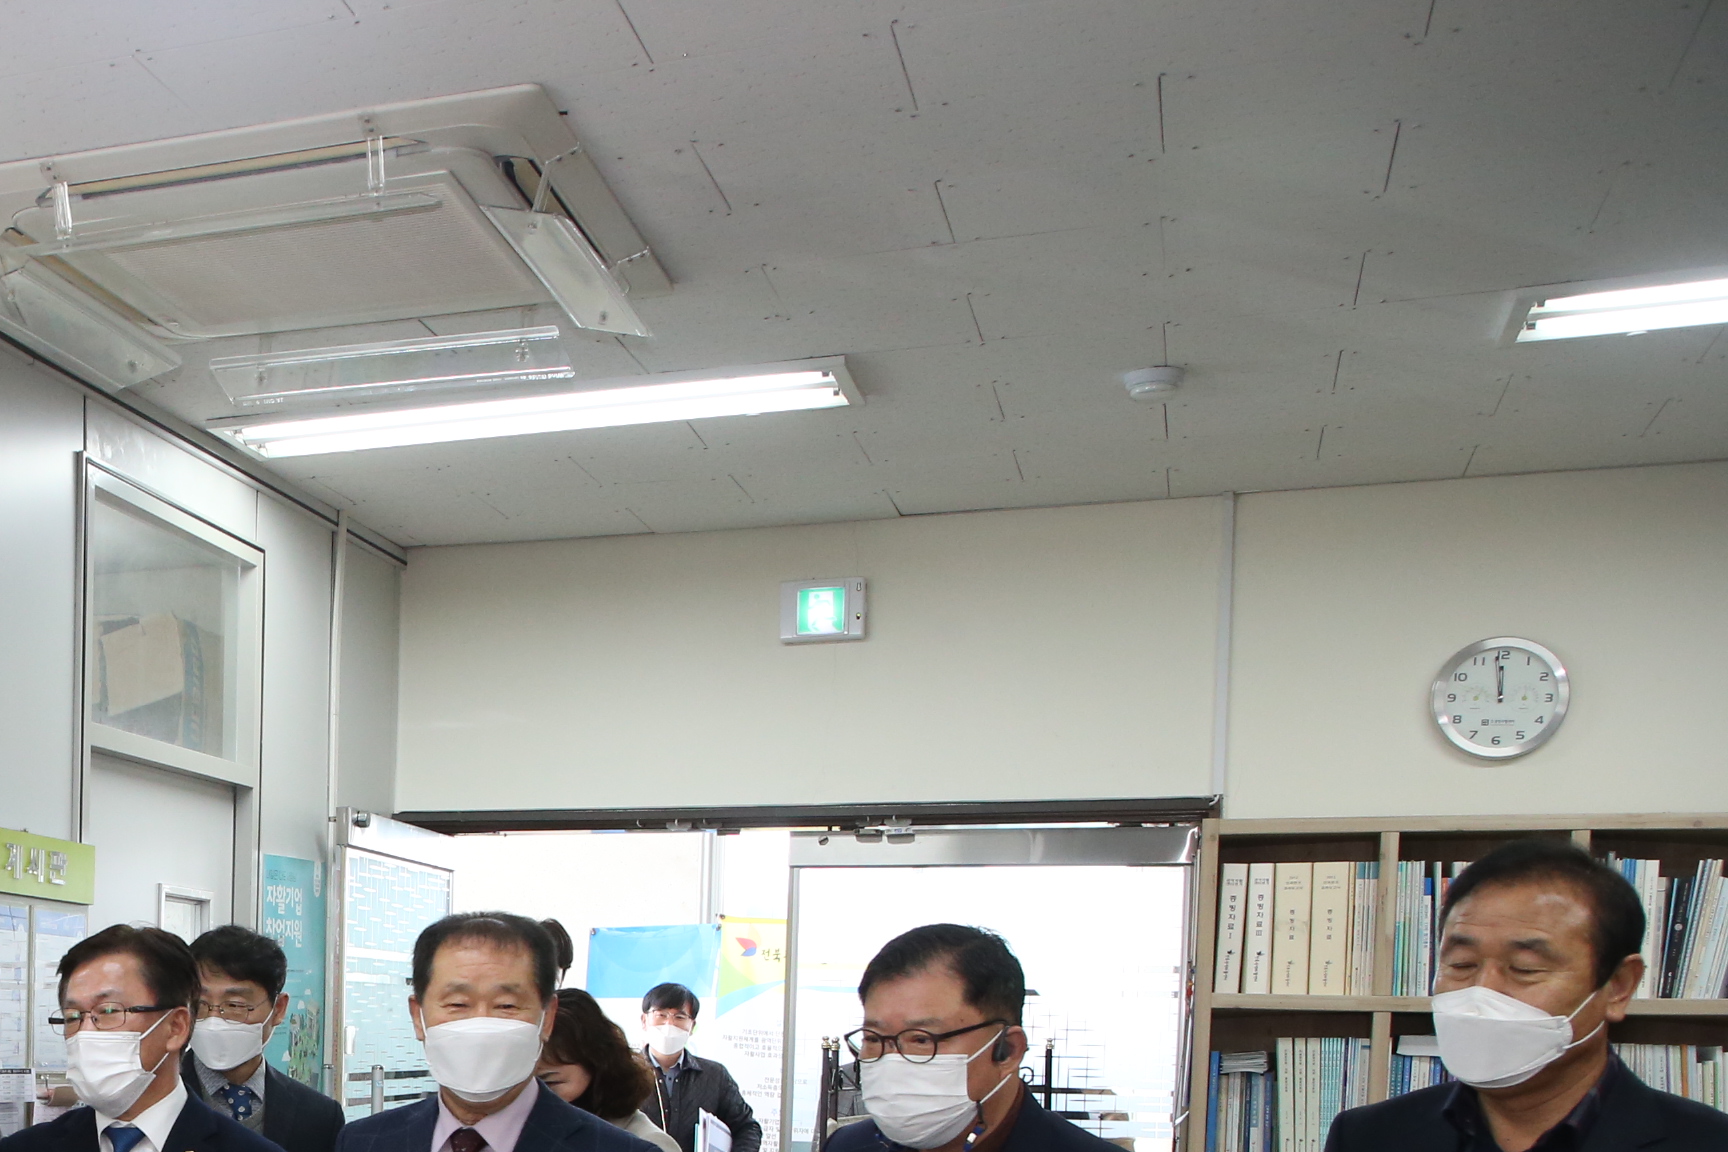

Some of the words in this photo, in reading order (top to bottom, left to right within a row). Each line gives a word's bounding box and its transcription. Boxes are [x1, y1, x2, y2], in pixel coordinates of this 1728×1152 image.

[1473, 657, 1486, 666] 11
[1526, 656, 1531, 666] 1
[1454, 672, 1468, 682] 10
[1540, 672, 1549, 682] 2
[1447, 694, 1456, 702] 9
[1544, 694, 1554, 702] 3
[1452, 715, 1462, 724] 8
[1534, 716, 1544, 724] 4
[1469, 730, 1478, 740] 7
[1516, 731, 1525, 740] 5
[1491, 736, 1500, 745] 6
[266, 884, 302, 916] 자활기업
[744, 1050, 766, 1058] 자활사업
